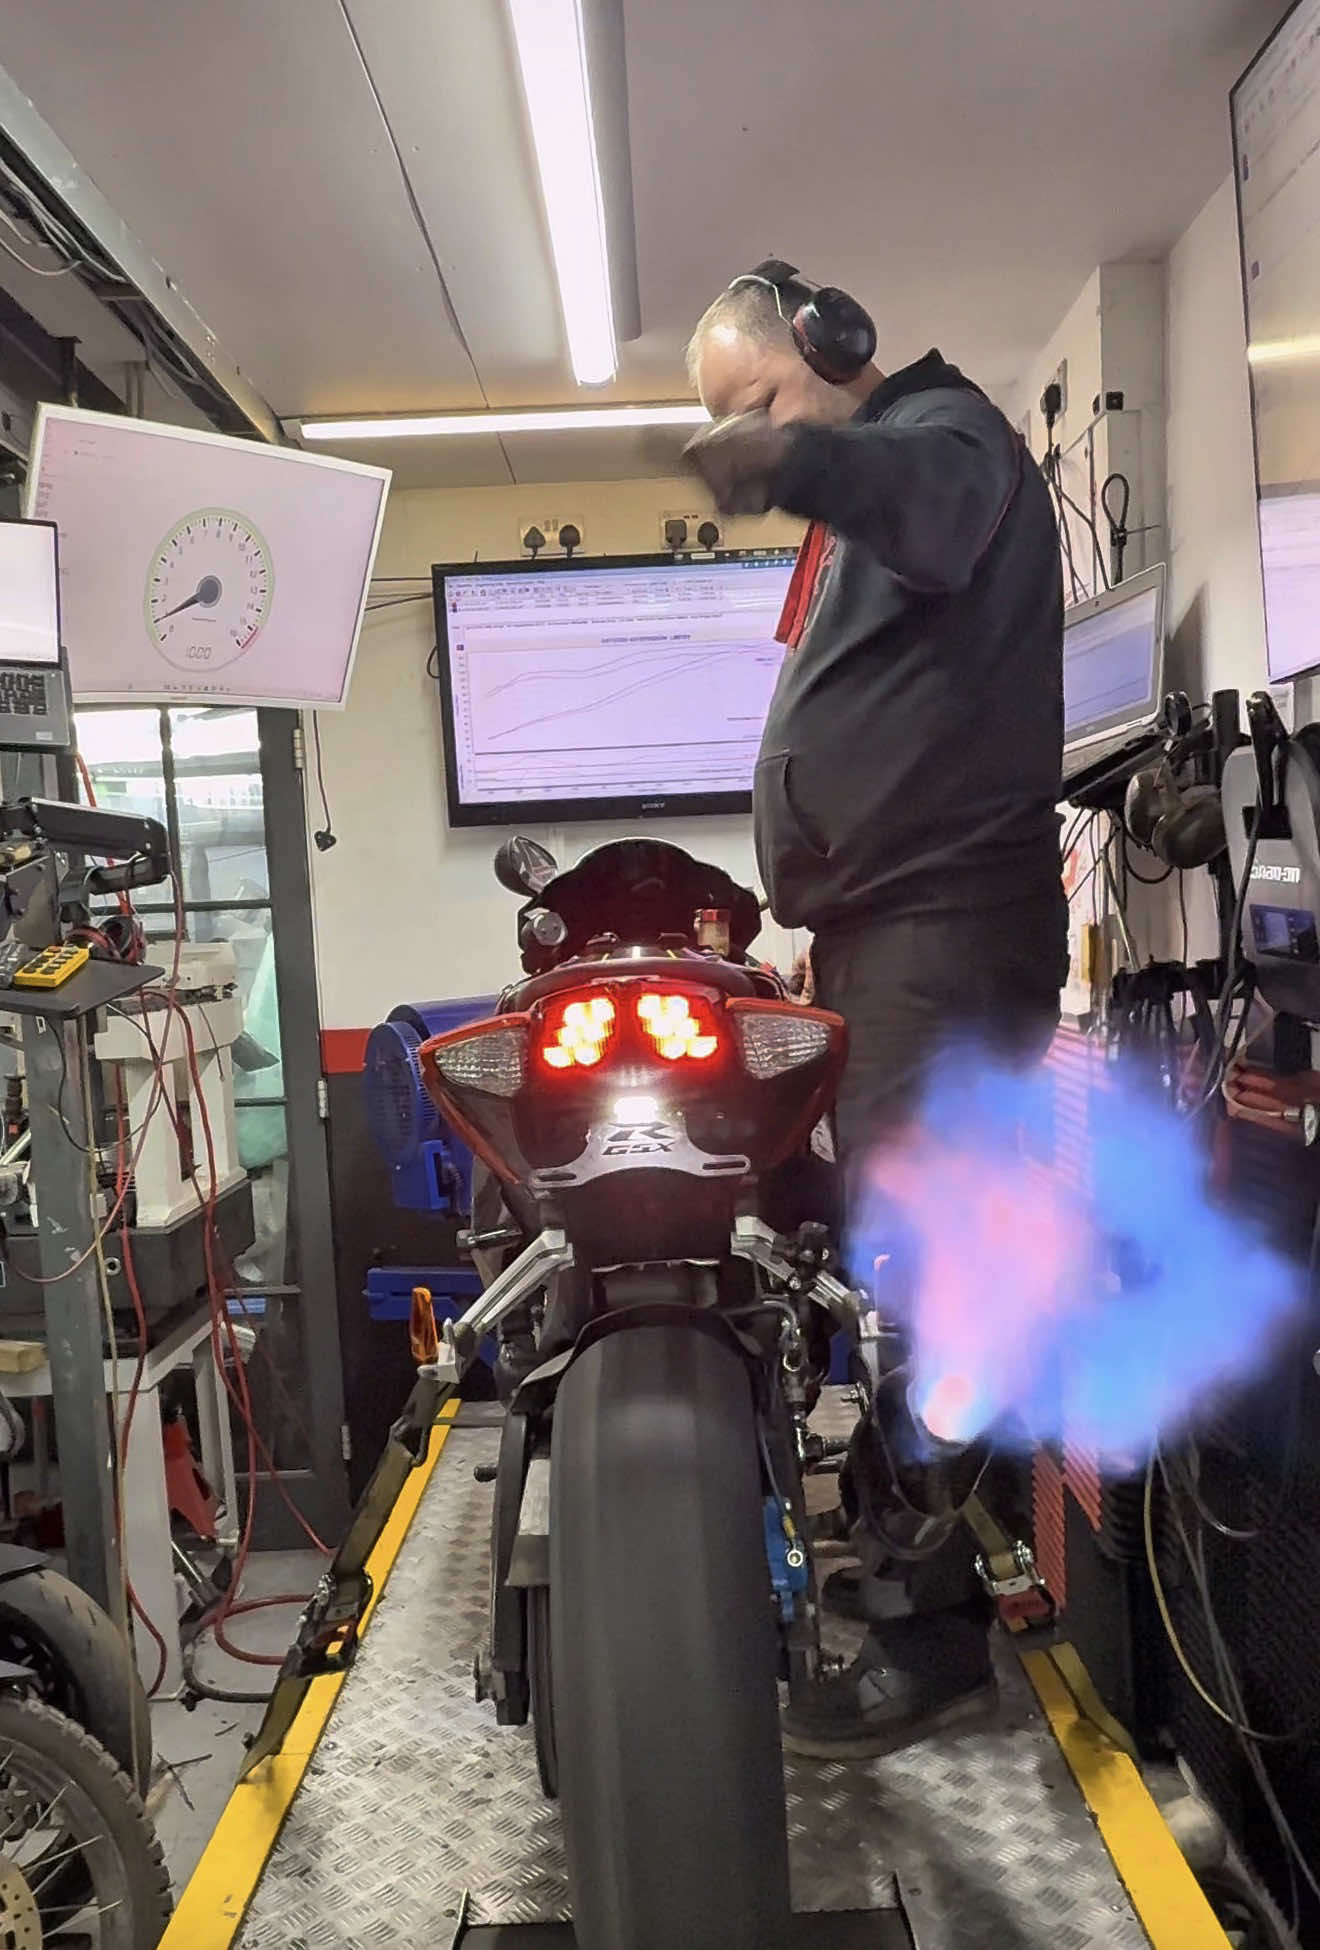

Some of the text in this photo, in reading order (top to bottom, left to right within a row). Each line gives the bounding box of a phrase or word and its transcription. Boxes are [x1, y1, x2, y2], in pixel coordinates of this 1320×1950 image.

[186, 645, 212, 659] 1000
[606, 1121, 675, 1142] R
[602, 1141, 676, 1156] GSX
